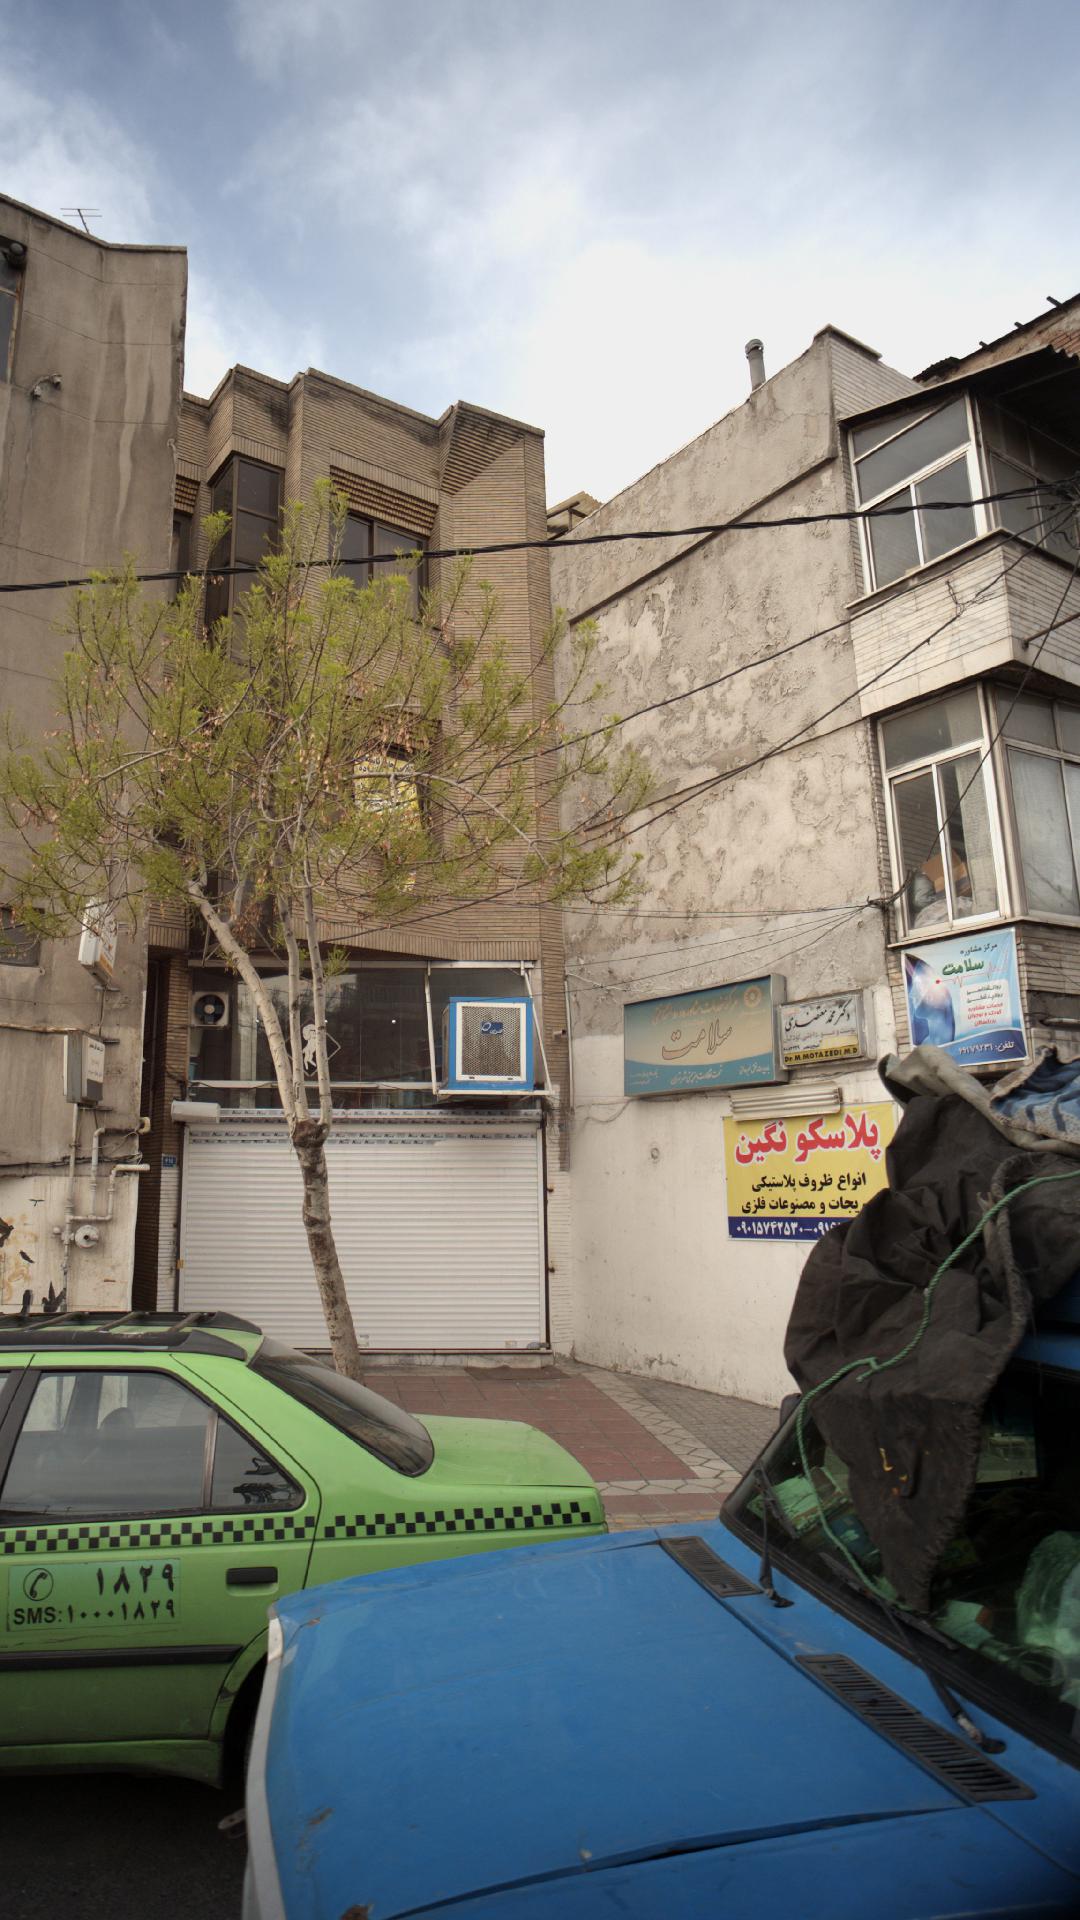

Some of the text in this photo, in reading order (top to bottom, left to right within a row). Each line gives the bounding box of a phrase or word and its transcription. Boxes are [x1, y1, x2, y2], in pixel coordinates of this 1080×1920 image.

[960, 943, 998, 957] مرکز مشاوره
[942, 958, 984, 976] سلامت
[834, 998, 853, 1026] دکتر
[661, 1016, 733, 1060] سلامت
[803, 1049, 842, 1060] MOTAZEDI
[735, 1112, 882, 1164] پلاسکو نگین
[751, 1171, 867, 1193] انواع ظروف پلاستیکی
[741, 1196, 863, 1215] یجات و مصنوعات فلزی
